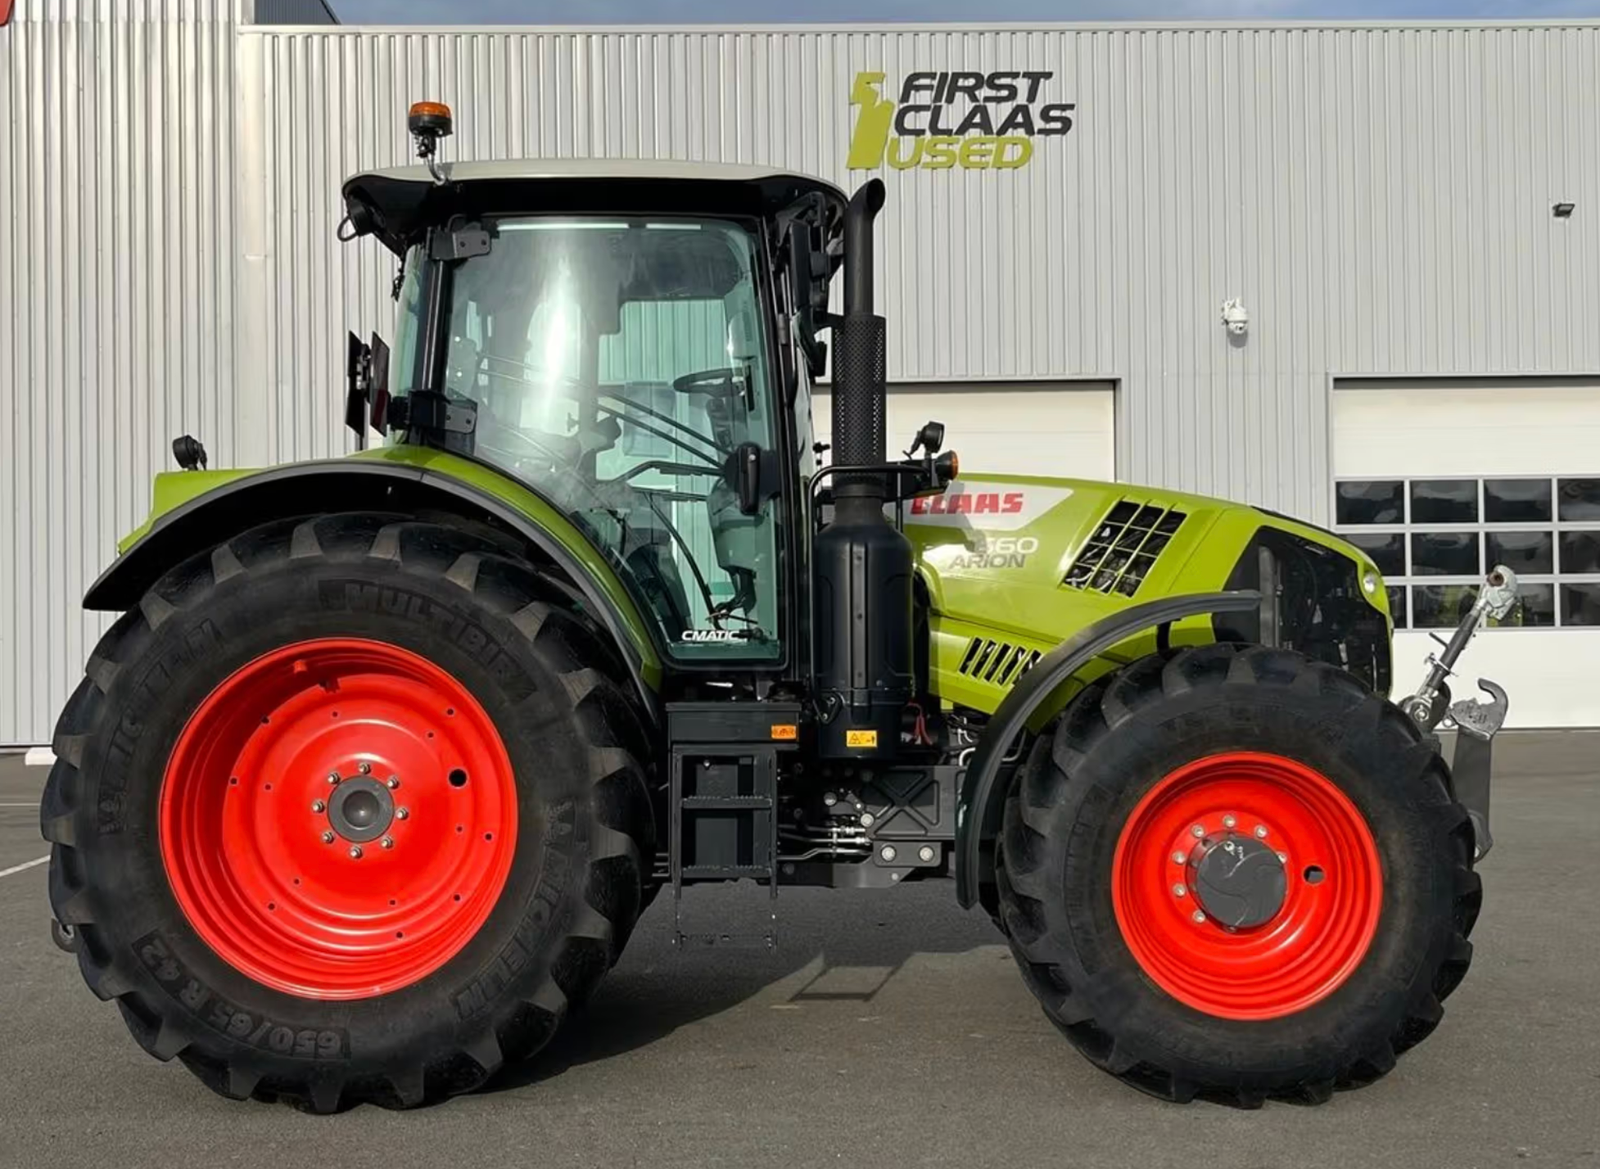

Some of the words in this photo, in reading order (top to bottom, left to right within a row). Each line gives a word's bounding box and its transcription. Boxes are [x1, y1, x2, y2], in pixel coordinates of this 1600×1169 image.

[899, 71, 1053, 104] FIRST
[894, 103, 1075, 136] CLAAS
[887, 136, 1033, 169] USED
[911, 493, 1023, 515] CLAAS
[949, 552, 1026, 570] ARION
[681, 630, 740, 642] CMATIC
[141, 937, 181, 981] 42
[178, 977, 206, 1009] R
[208, 1001, 342, 1056] 650/65
